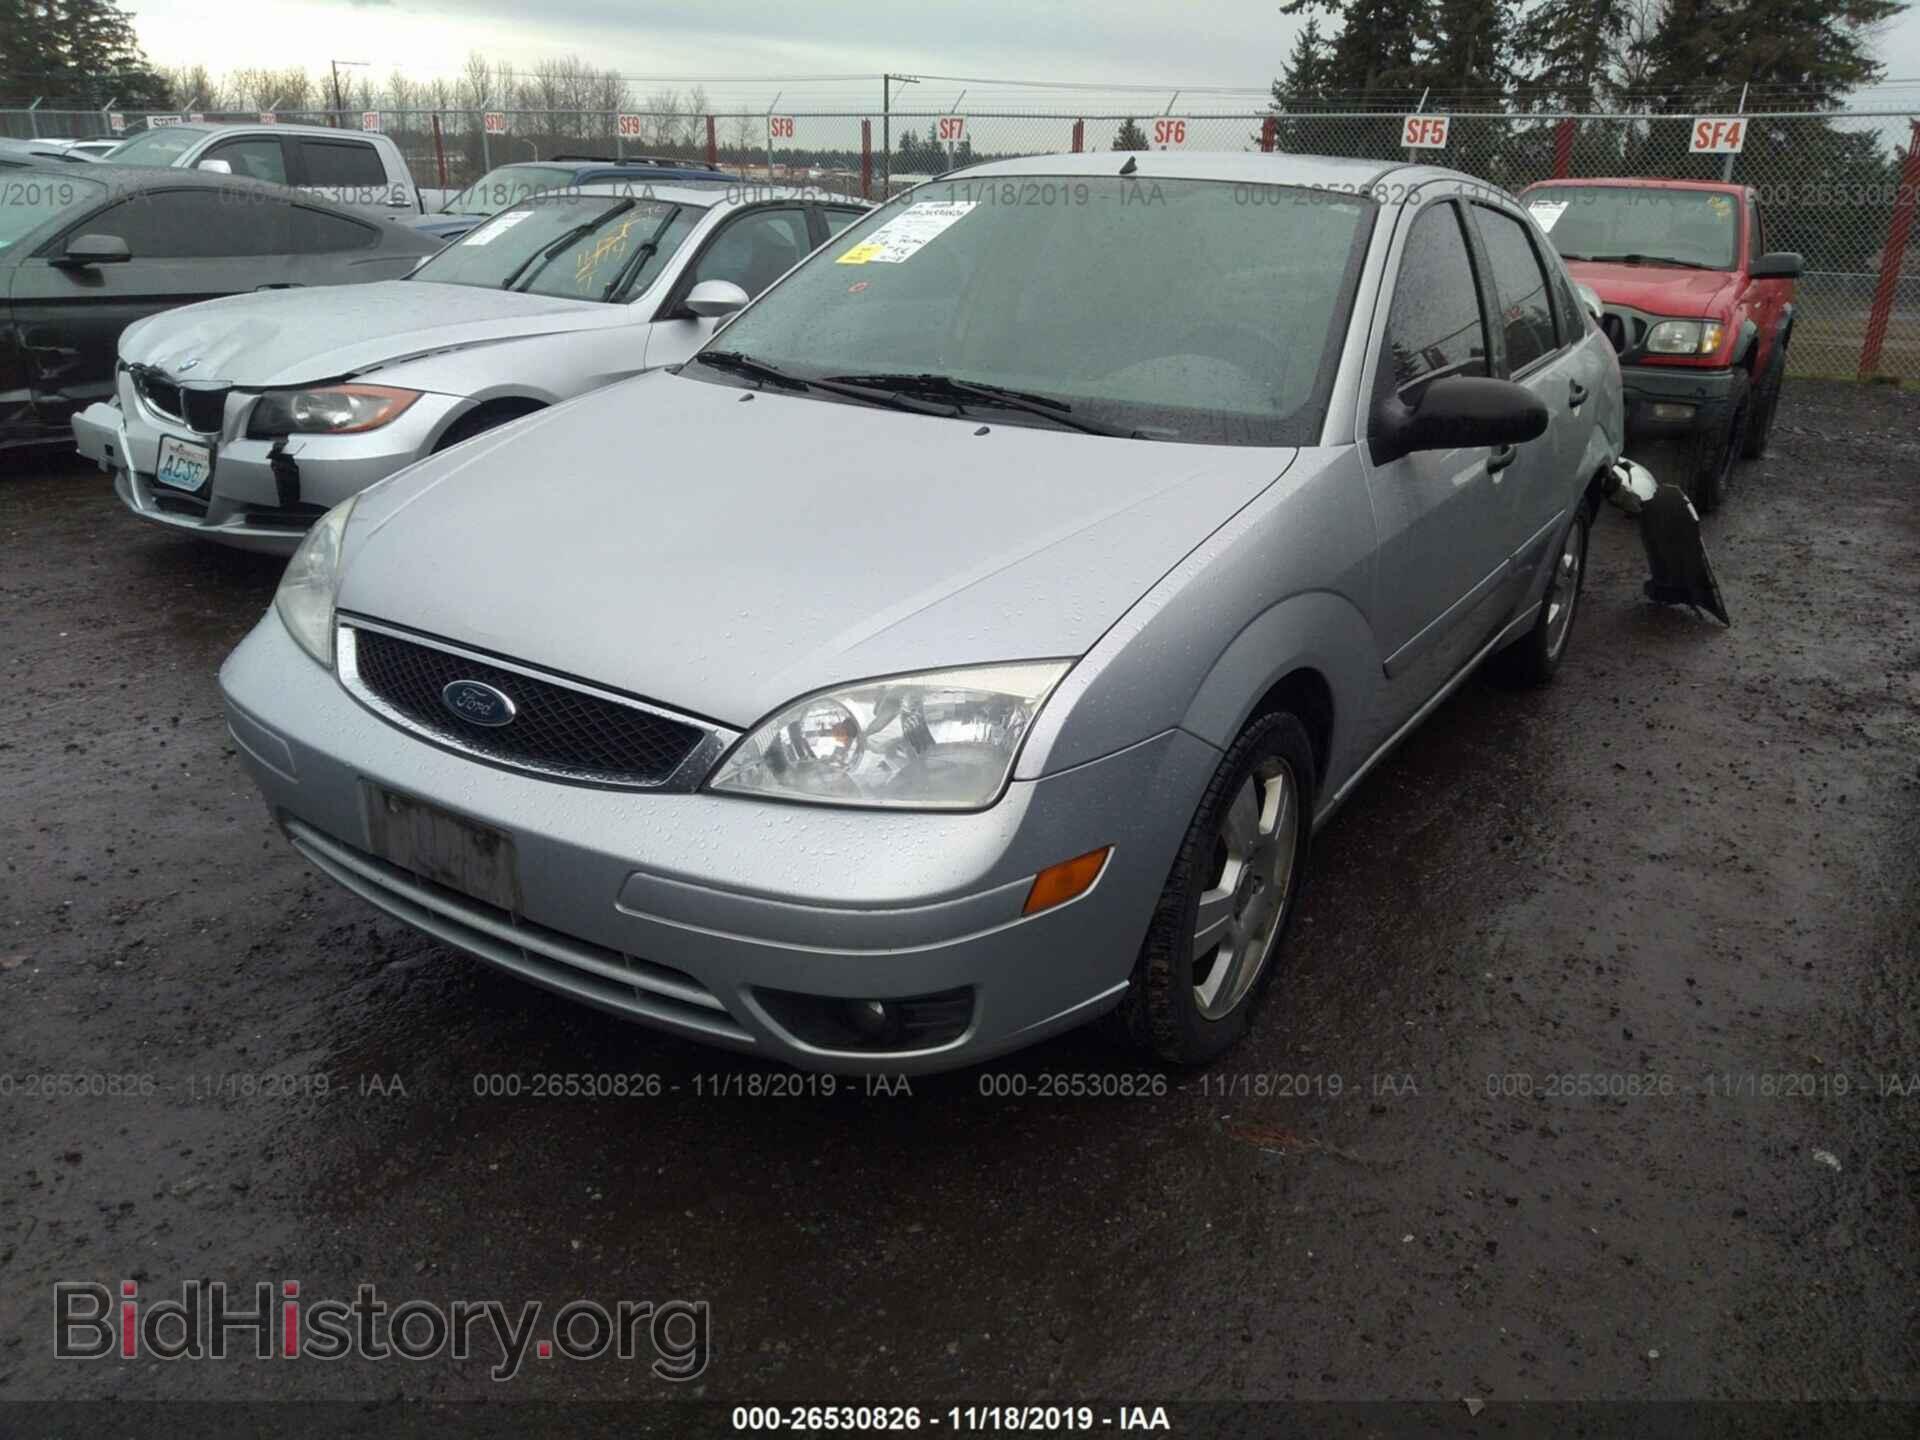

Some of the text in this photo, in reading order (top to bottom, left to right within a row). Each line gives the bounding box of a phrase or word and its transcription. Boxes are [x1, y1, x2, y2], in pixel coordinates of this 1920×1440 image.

[620, 116, 640, 134] SF9
[771, 118, 793, 137] SF8
[939, 119, 965, 140] SF7
[1154, 120, 1185, 144] SF6
[1405, 119, 1447, 145] SF5
[1695, 121, 1741, 149] SF4
[455, 687, 496, 716] Ford
